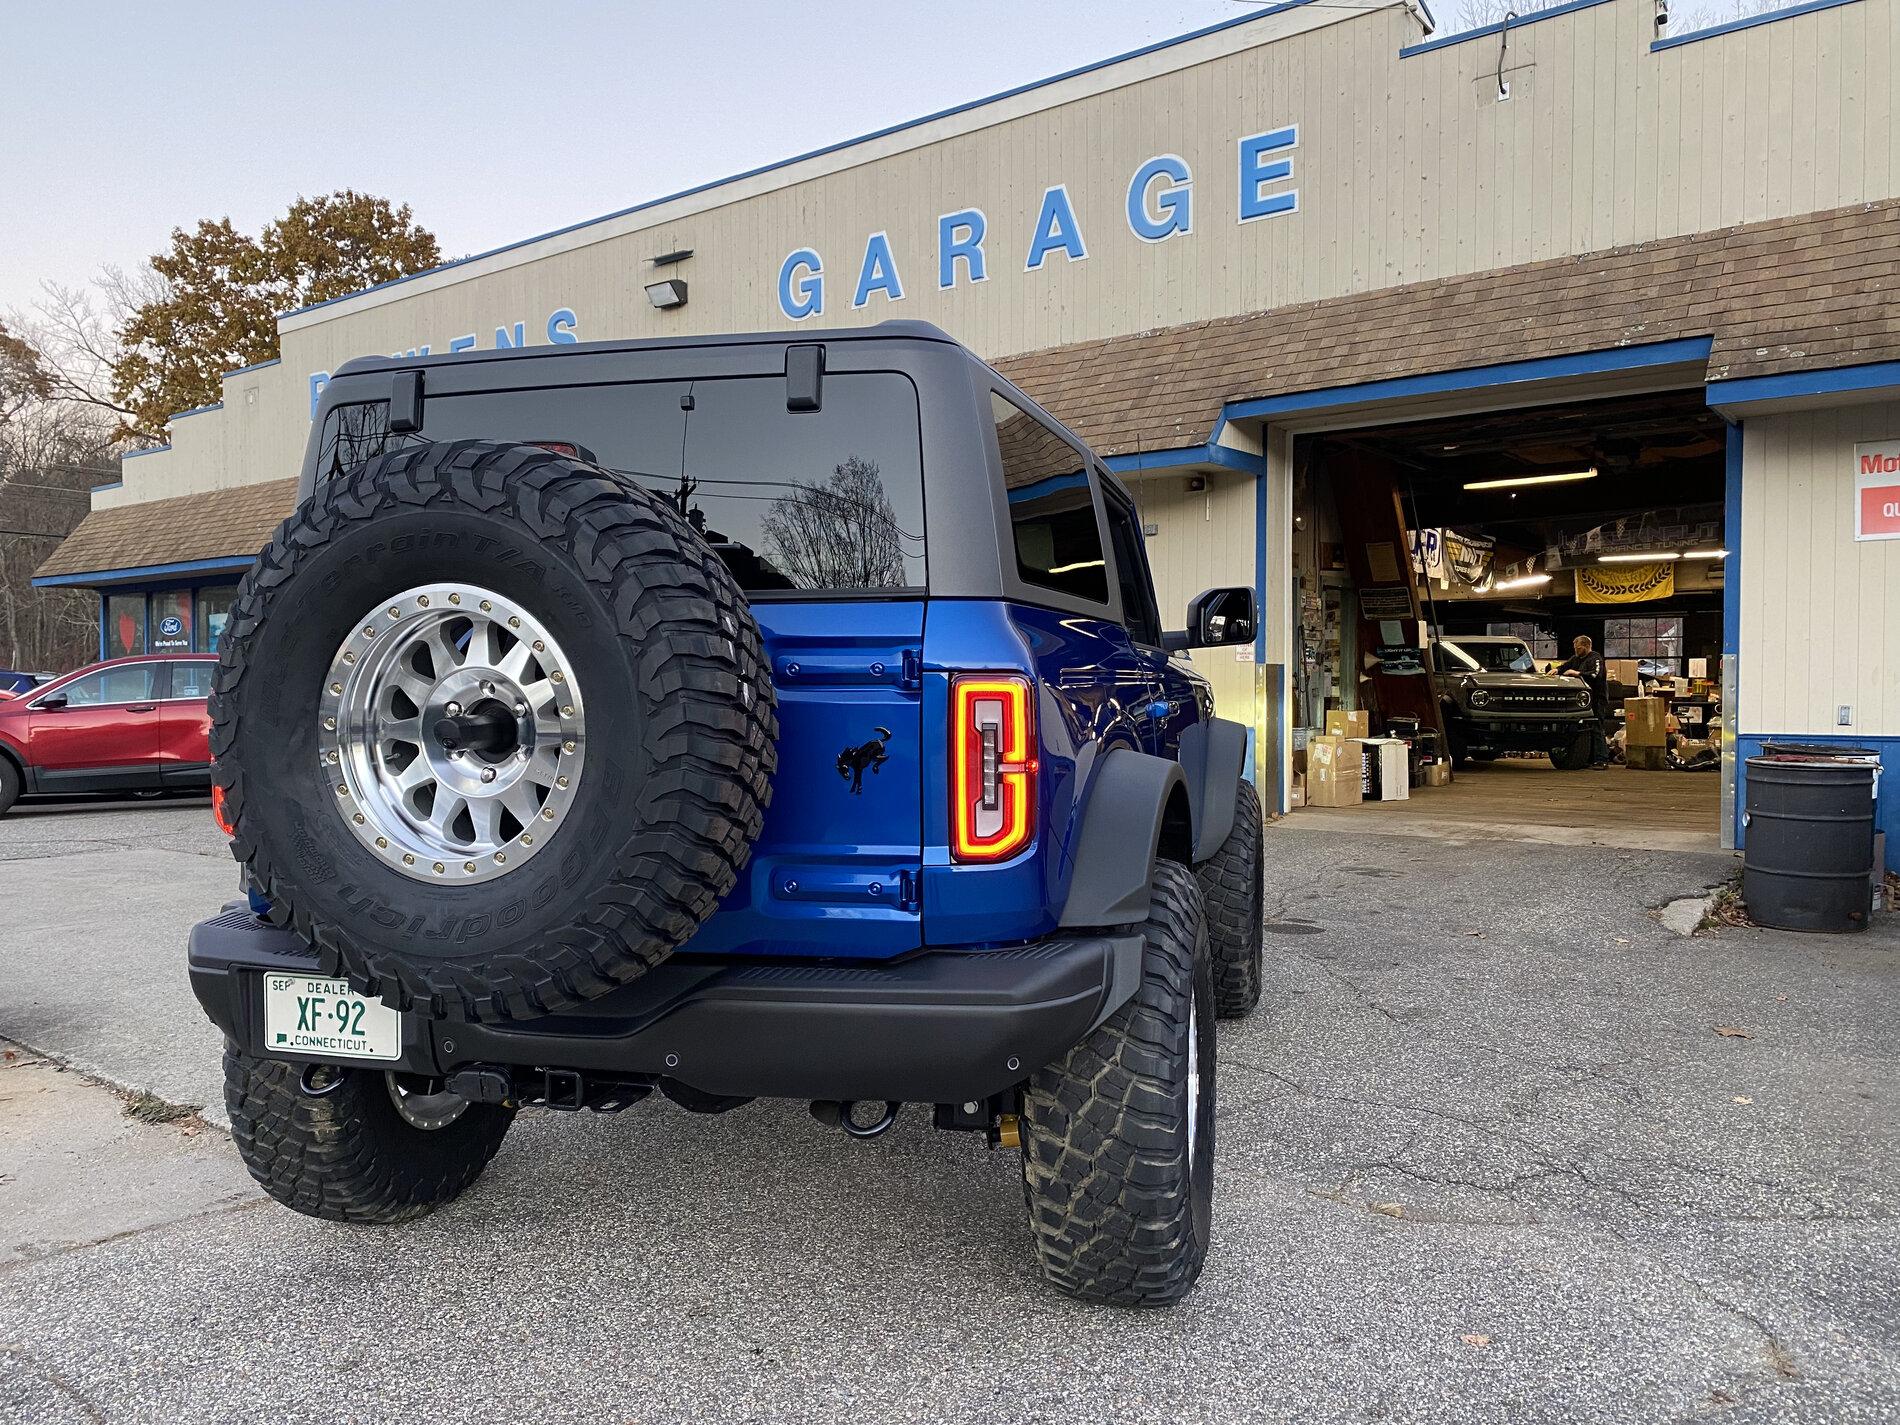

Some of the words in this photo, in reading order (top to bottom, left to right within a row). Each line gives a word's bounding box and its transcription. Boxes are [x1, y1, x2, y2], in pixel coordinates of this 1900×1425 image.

[309, 307, 579, 424] BNS
[777, 122, 1300, 322] GARAGE
[1655, 539, 1699, 550] TUNING
[337, 757, 624, 945] BFGoodrich
[295, 1035, 367, 1051] CONNECTICUT
